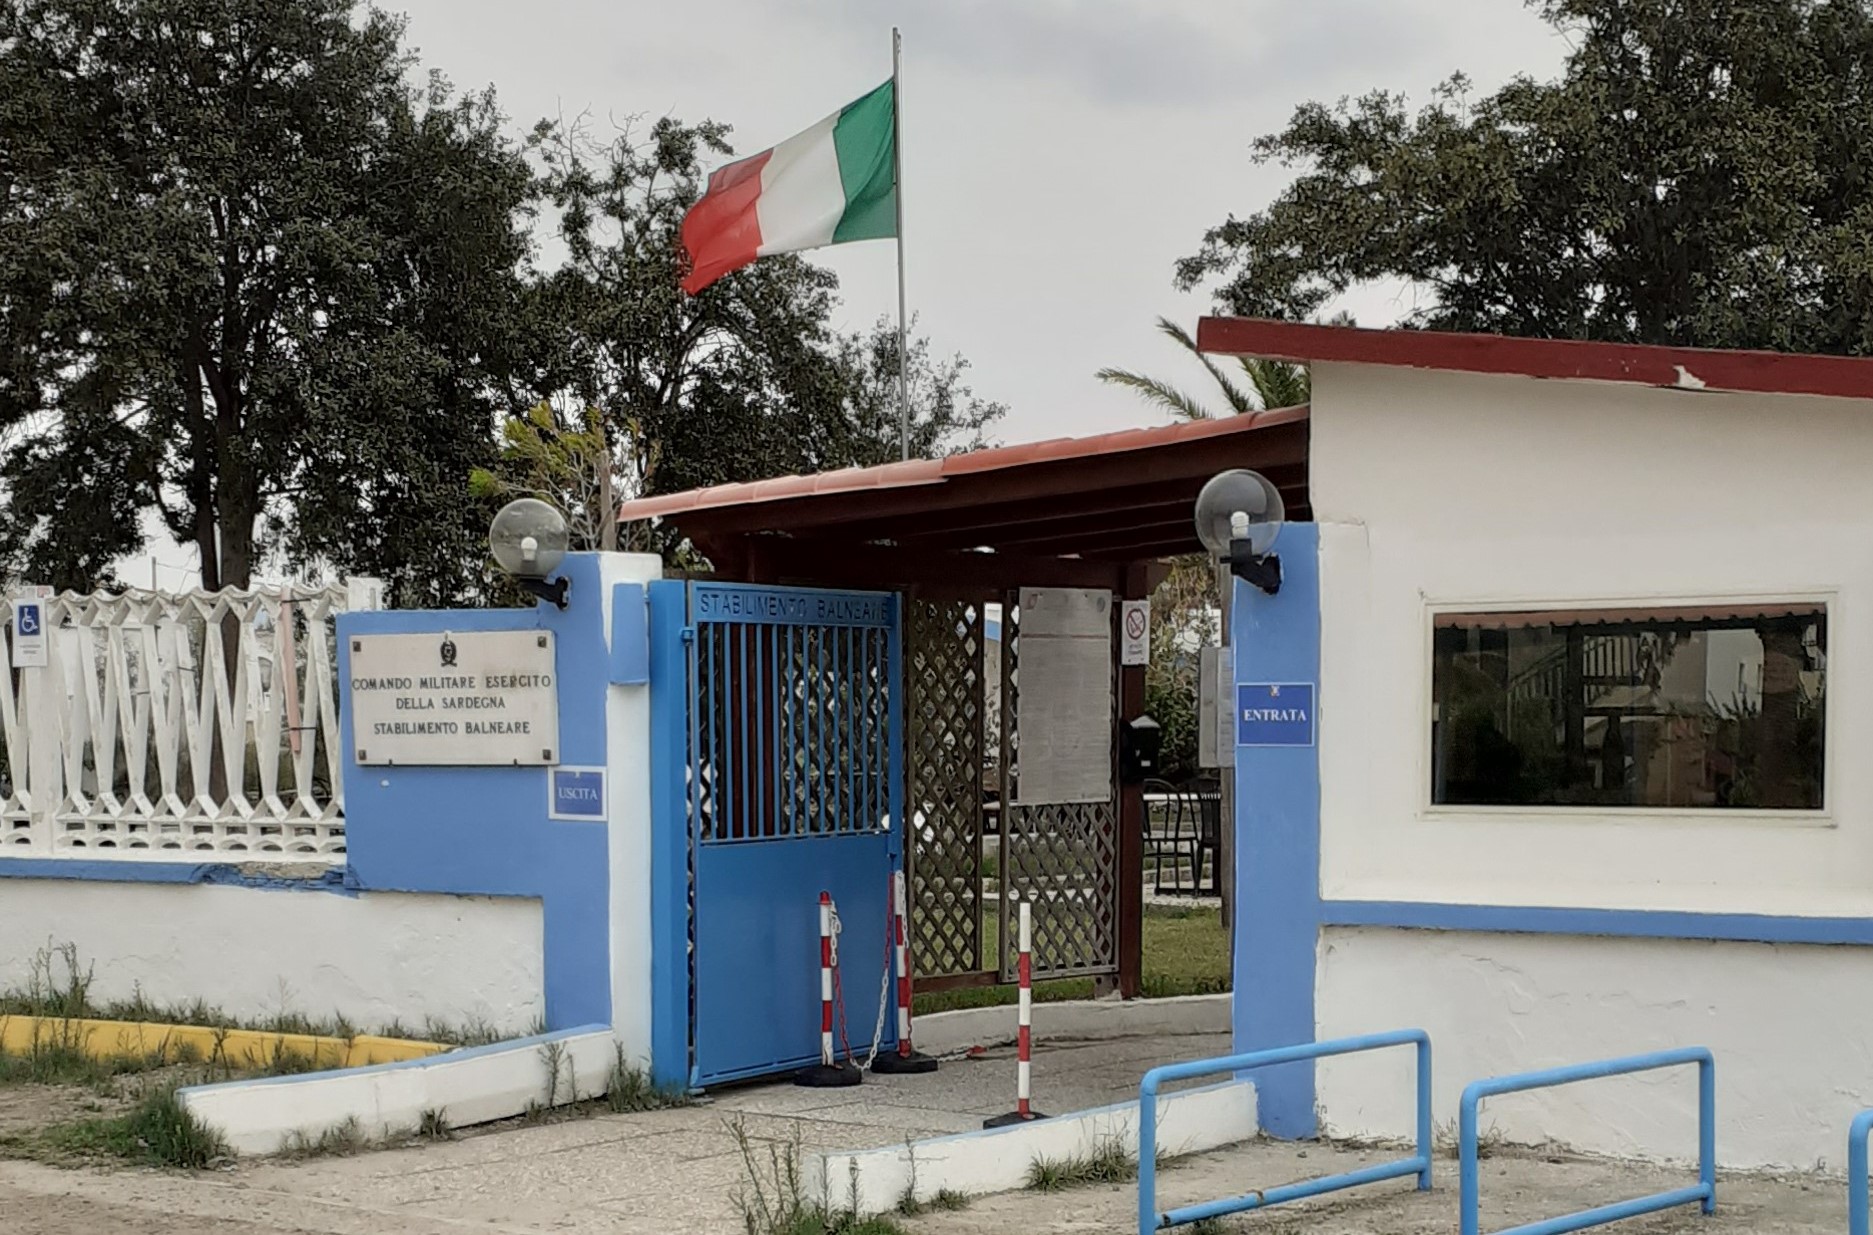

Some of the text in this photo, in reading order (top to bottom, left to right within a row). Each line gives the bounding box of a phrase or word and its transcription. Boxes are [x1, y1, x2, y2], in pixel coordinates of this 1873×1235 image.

[700, 593, 807, 617] STABILIMENTO
[352, 674, 551, 691] COMANDO MILITARE ESERCITO
[396, 696, 506, 710] DELLA SARDEGNA
[1243, 709, 1307, 721] ENTRATA
[374, 721, 530, 735] STABILIMENTO BALNEARE
[558, 787, 598, 801] USCITA
